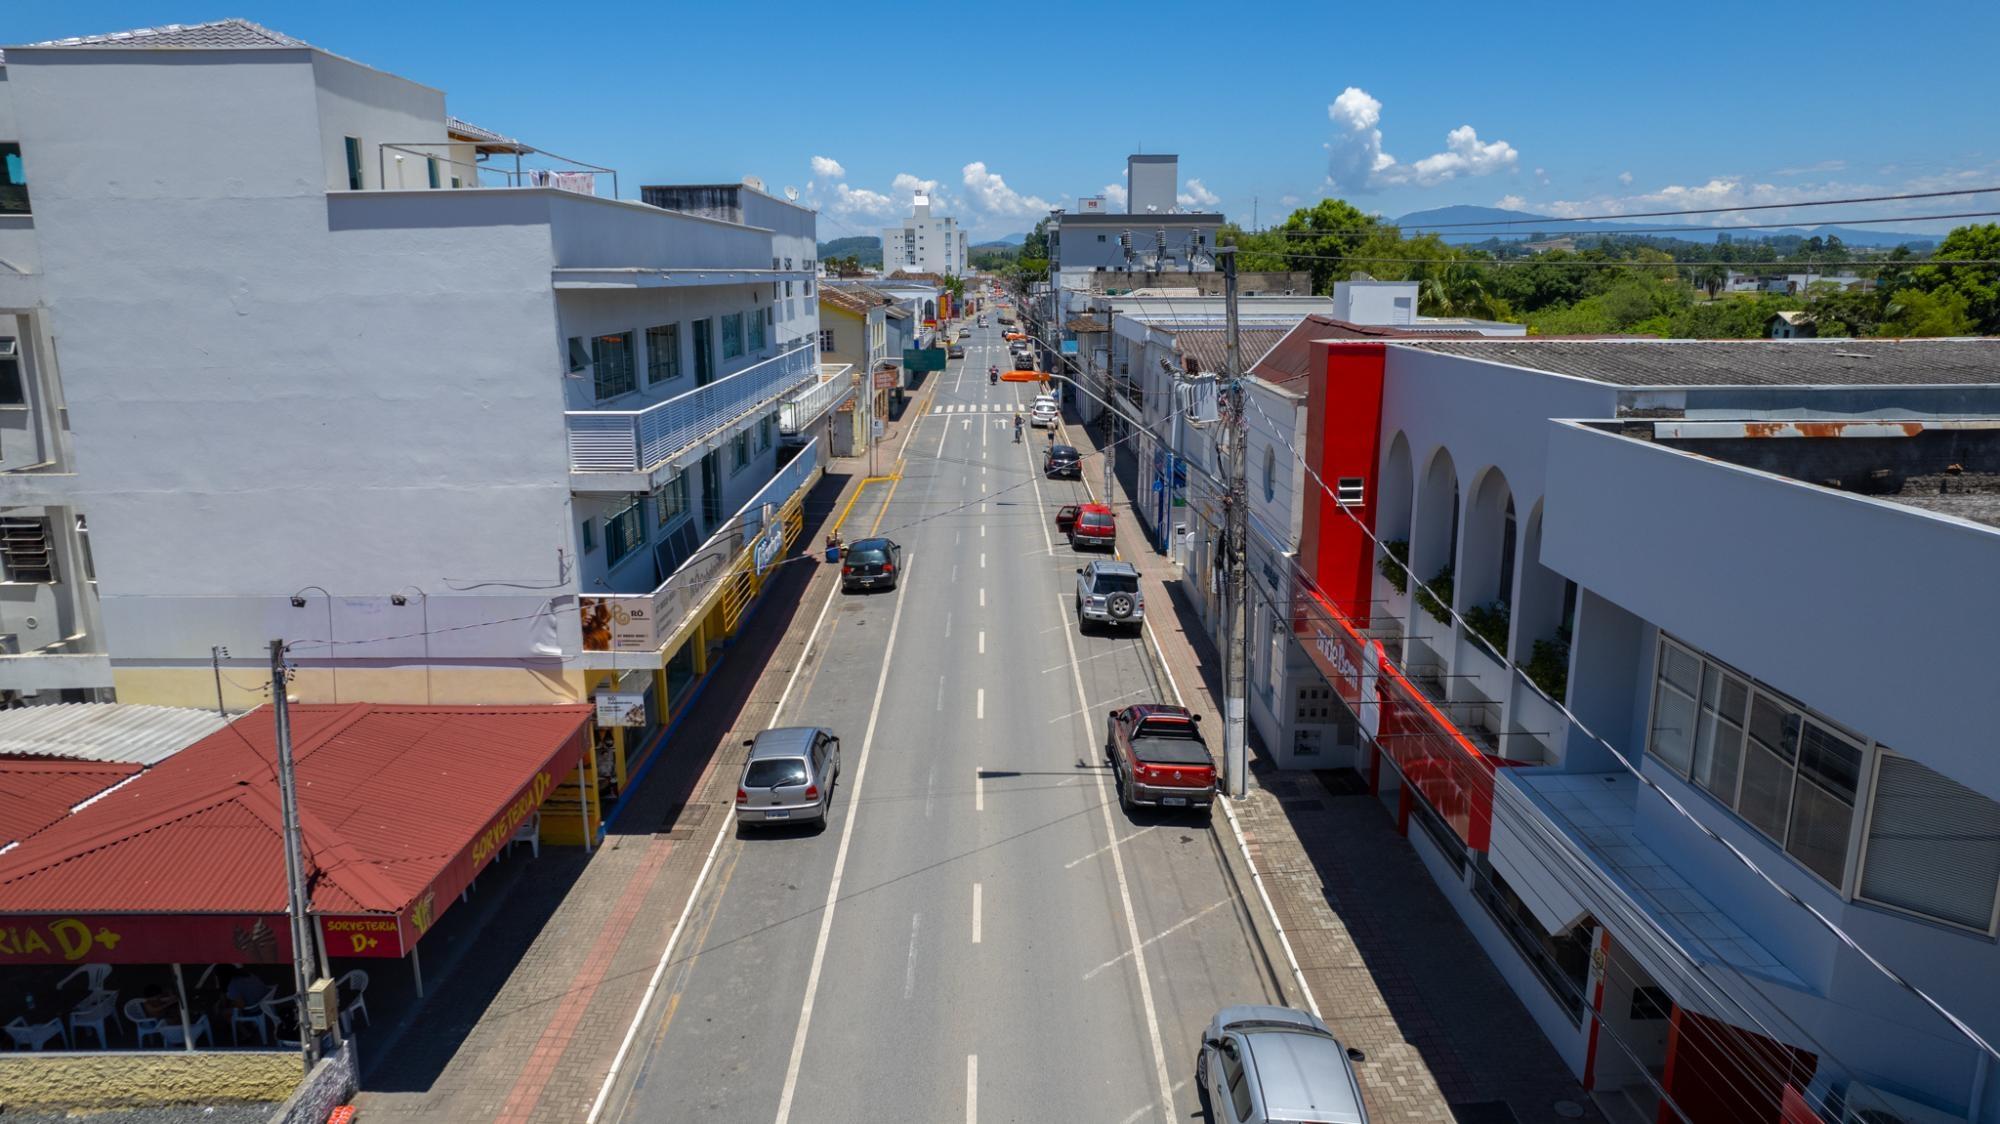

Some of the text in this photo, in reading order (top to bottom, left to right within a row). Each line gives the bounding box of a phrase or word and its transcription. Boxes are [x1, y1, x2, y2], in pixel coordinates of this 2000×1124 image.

[327, 920, 398, 931] SORVETERIA
[48, 918, 122, 960] D+
[351, 933, 378, 953] D+
